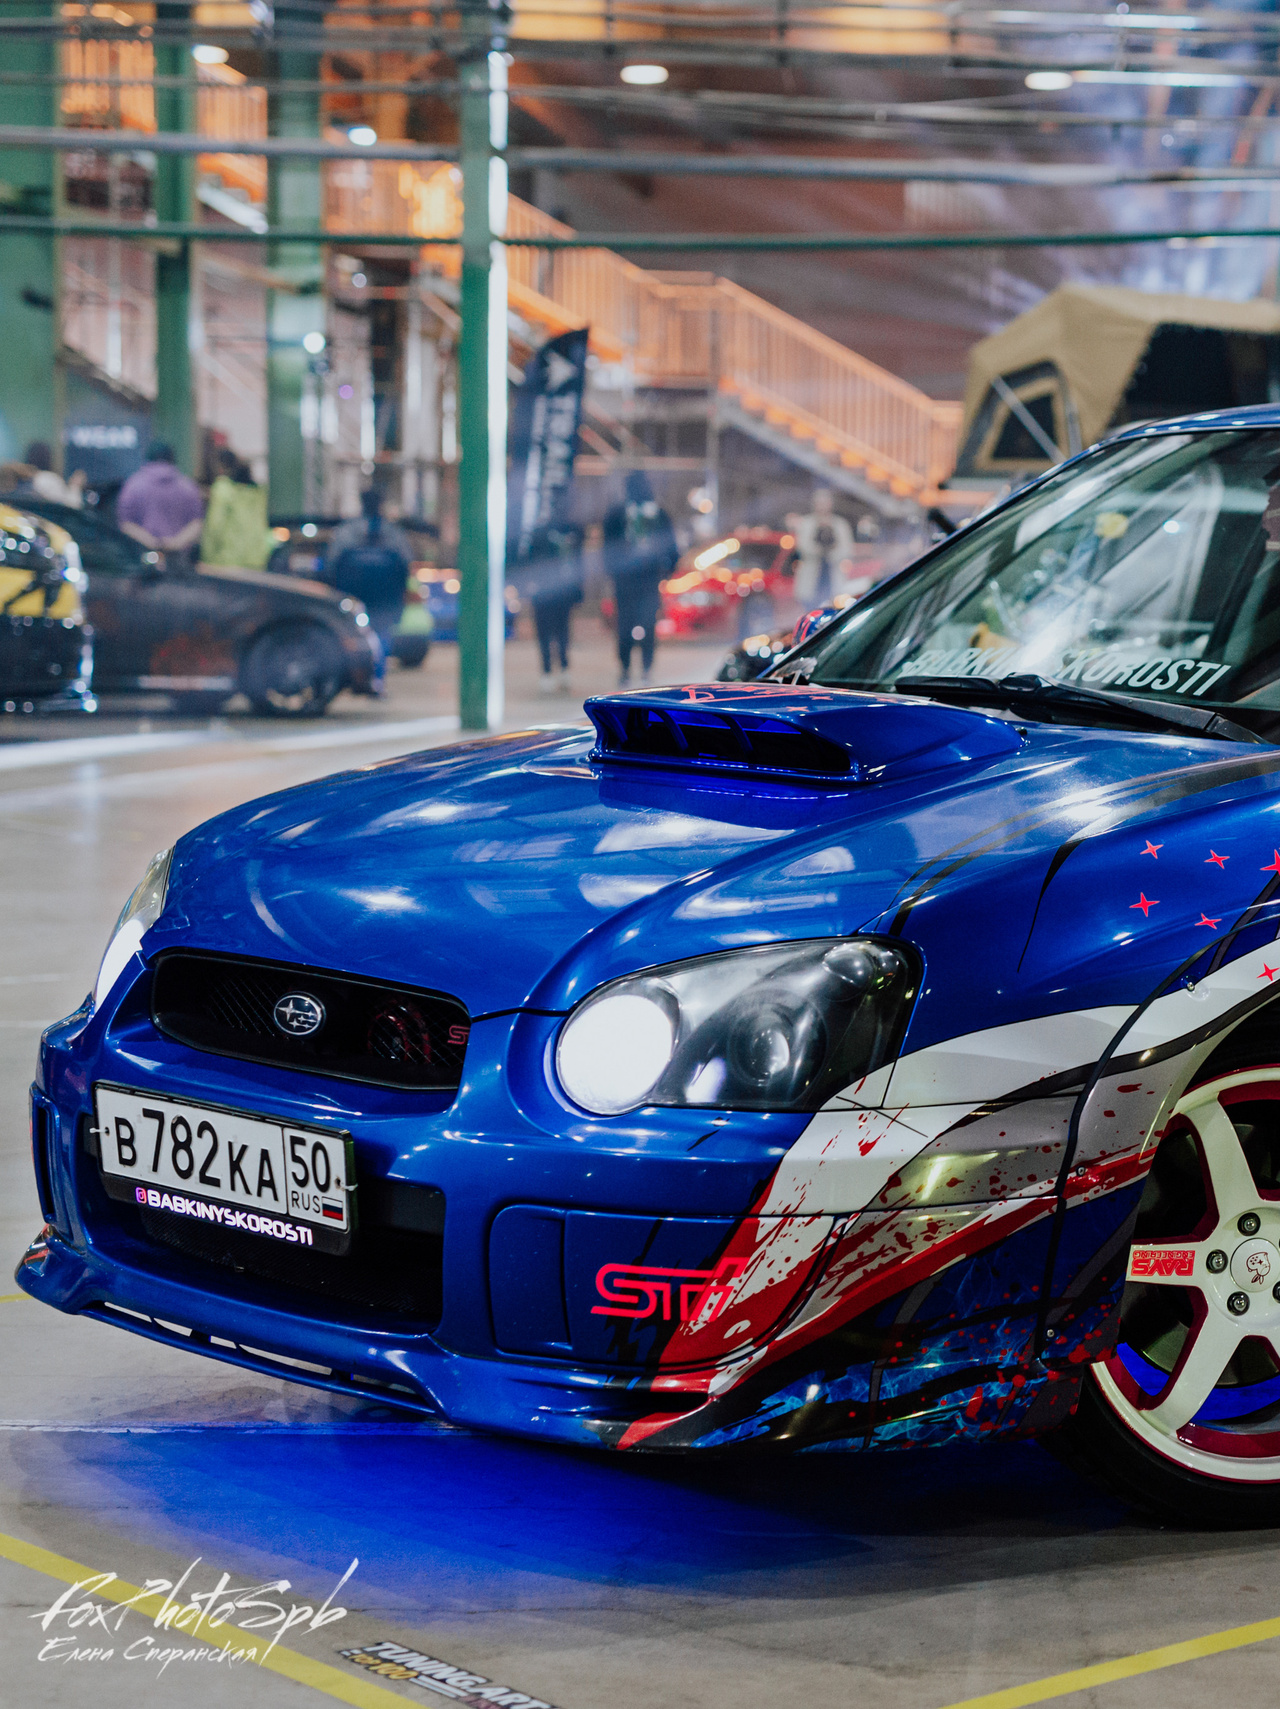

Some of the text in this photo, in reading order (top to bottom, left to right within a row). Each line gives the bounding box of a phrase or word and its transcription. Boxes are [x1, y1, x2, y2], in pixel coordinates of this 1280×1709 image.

[289, 1135, 331, 1193] 50
[291, 1190, 321, 1214] RUS
[1131, 1259, 1195, 1277] RAYS
[368, 1662, 419, 1681] 100
